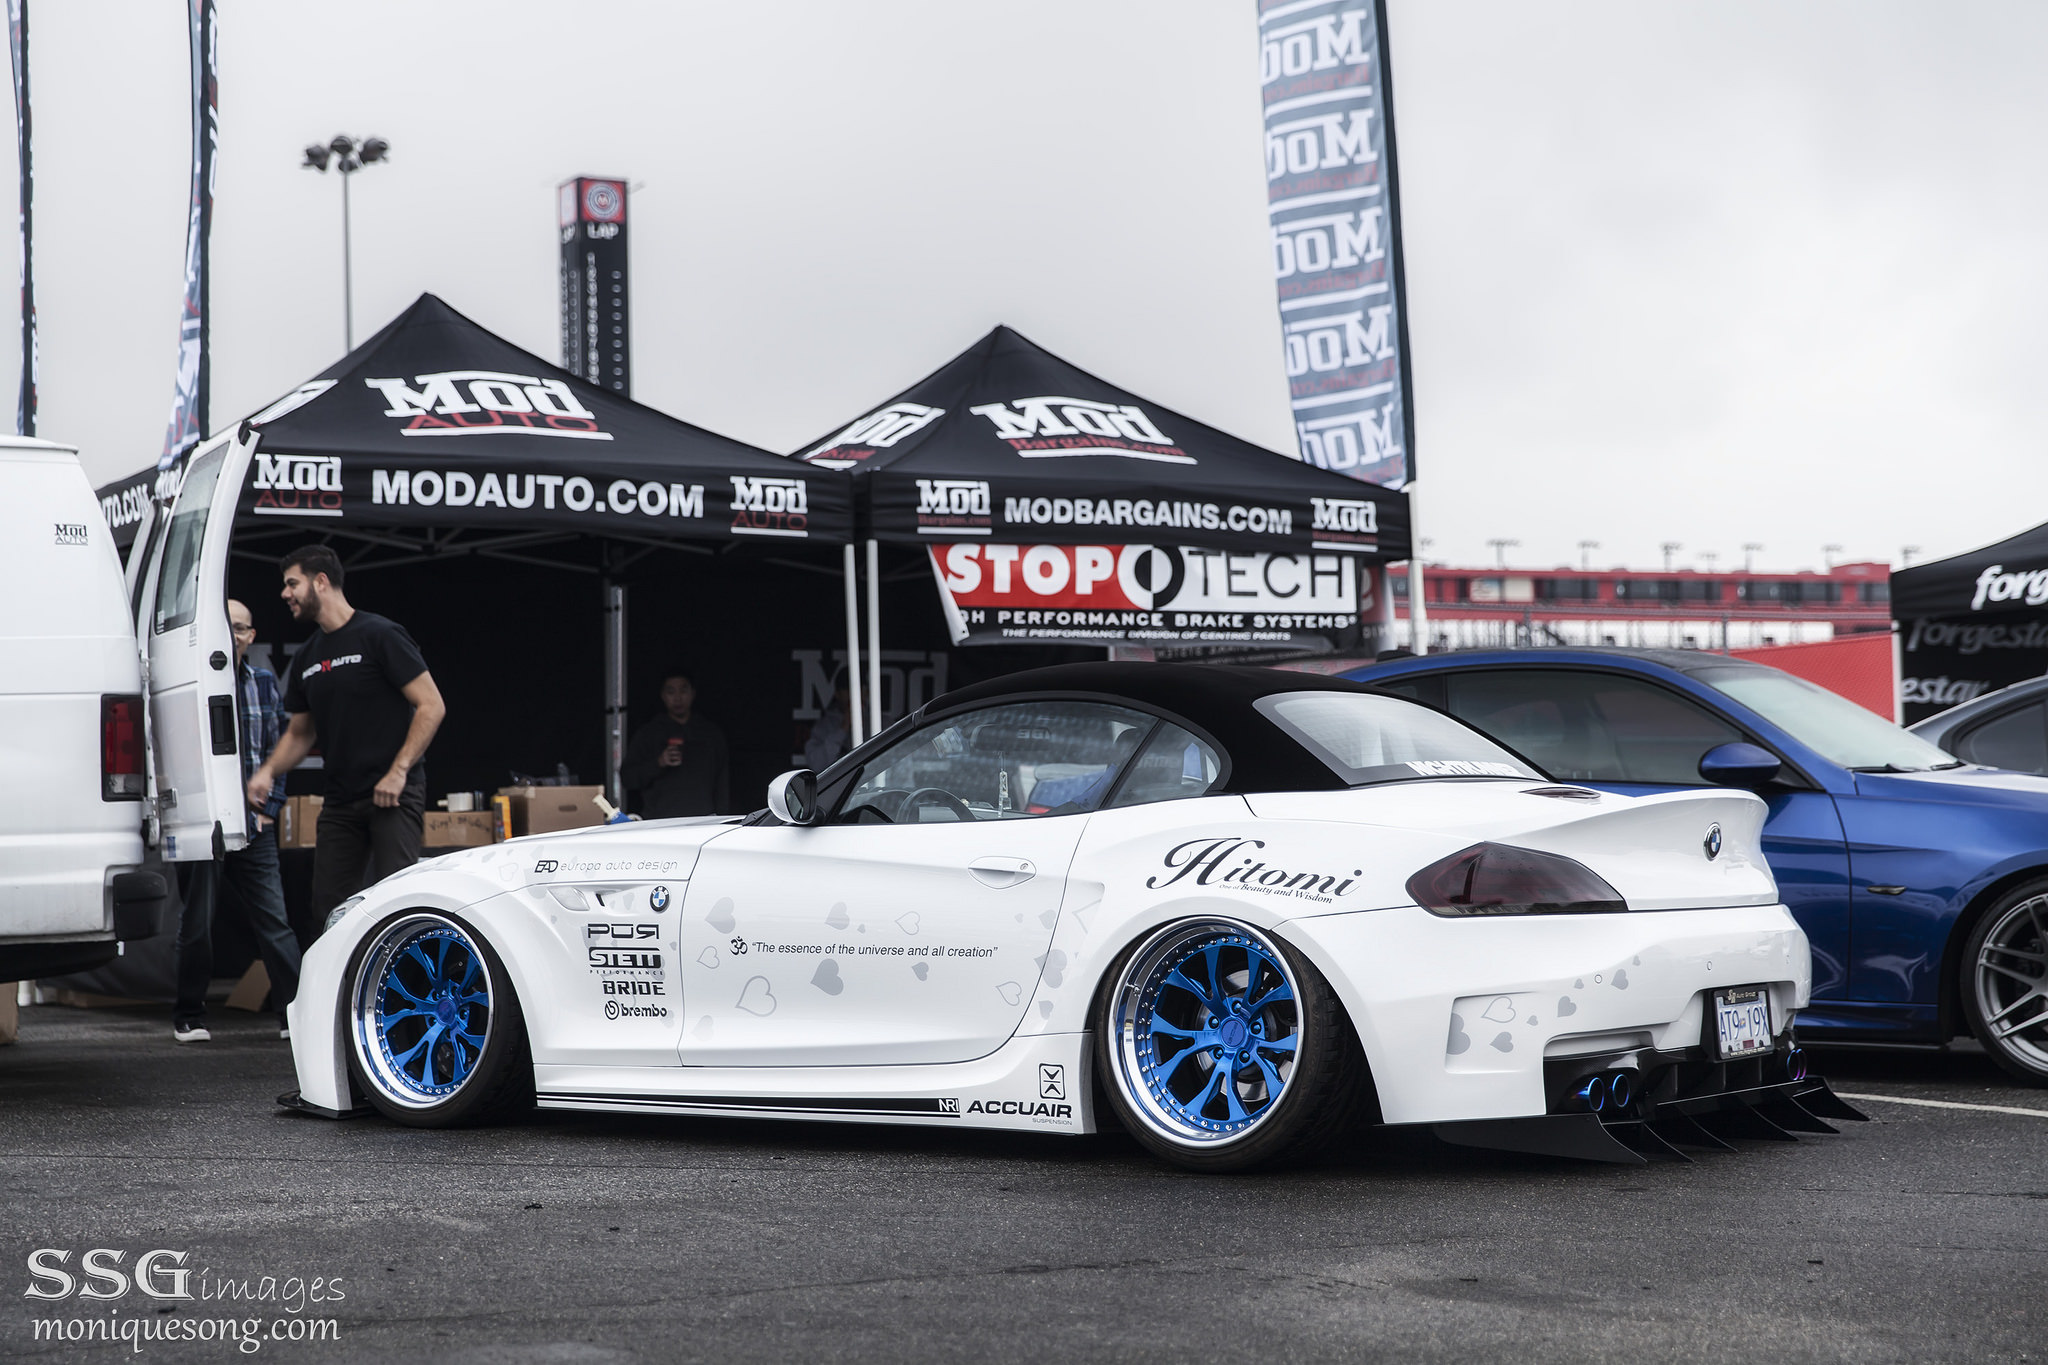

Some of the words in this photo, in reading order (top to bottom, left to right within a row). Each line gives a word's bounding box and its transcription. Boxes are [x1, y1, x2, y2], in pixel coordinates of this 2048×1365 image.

[364, 370, 595, 419] Mod
[405, 410, 600, 432] AUTO
[970, 396, 1174, 445] Mod
[253, 453, 343, 492] Mod
[255, 490, 343, 510] AUTO
[372, 469, 704, 518] MODAUTO.COM
[730, 476, 808, 514] Mod
[916, 480, 991, 515] Mod
[731, 511, 808, 530] AUTO
[1004, 498, 1292, 534] MODBARGAINS.COM
[1310, 498, 1378, 533] Mod
[54, 523, 88, 537] Mod
[998, 611, 1164, 626] PERFORMANCE
[1174, 613, 1244, 628] BRAKE
[560, 861, 602, 873] europa
[605, 860, 632, 871] auto
[637, 859, 679, 873] design
[1146, 837, 1363, 896] Hitomi
[1240, 883, 1273, 895] Beauty
[1274, 888, 1293, 897] and
[1295, 890, 1333, 904] Wisdom
[778, 943, 822, 954] essence
[825, 943, 837, 954] of
[838, 943, 855, 955] the
[858, 944, 904, 956] universe
[907, 945, 929, 956] and
[931, 945, 945, 957] all
[602, 981, 666, 996] BRIDE
[621, 1003, 667, 1018] brembo
[1720, 1010, 1740, 1041] AT9
[1747, 1005, 1770, 1037] 19X
[966, 1100, 1072, 1118] ACCUAIR
[1032, 1117, 1073, 1126] SUSPENSION
